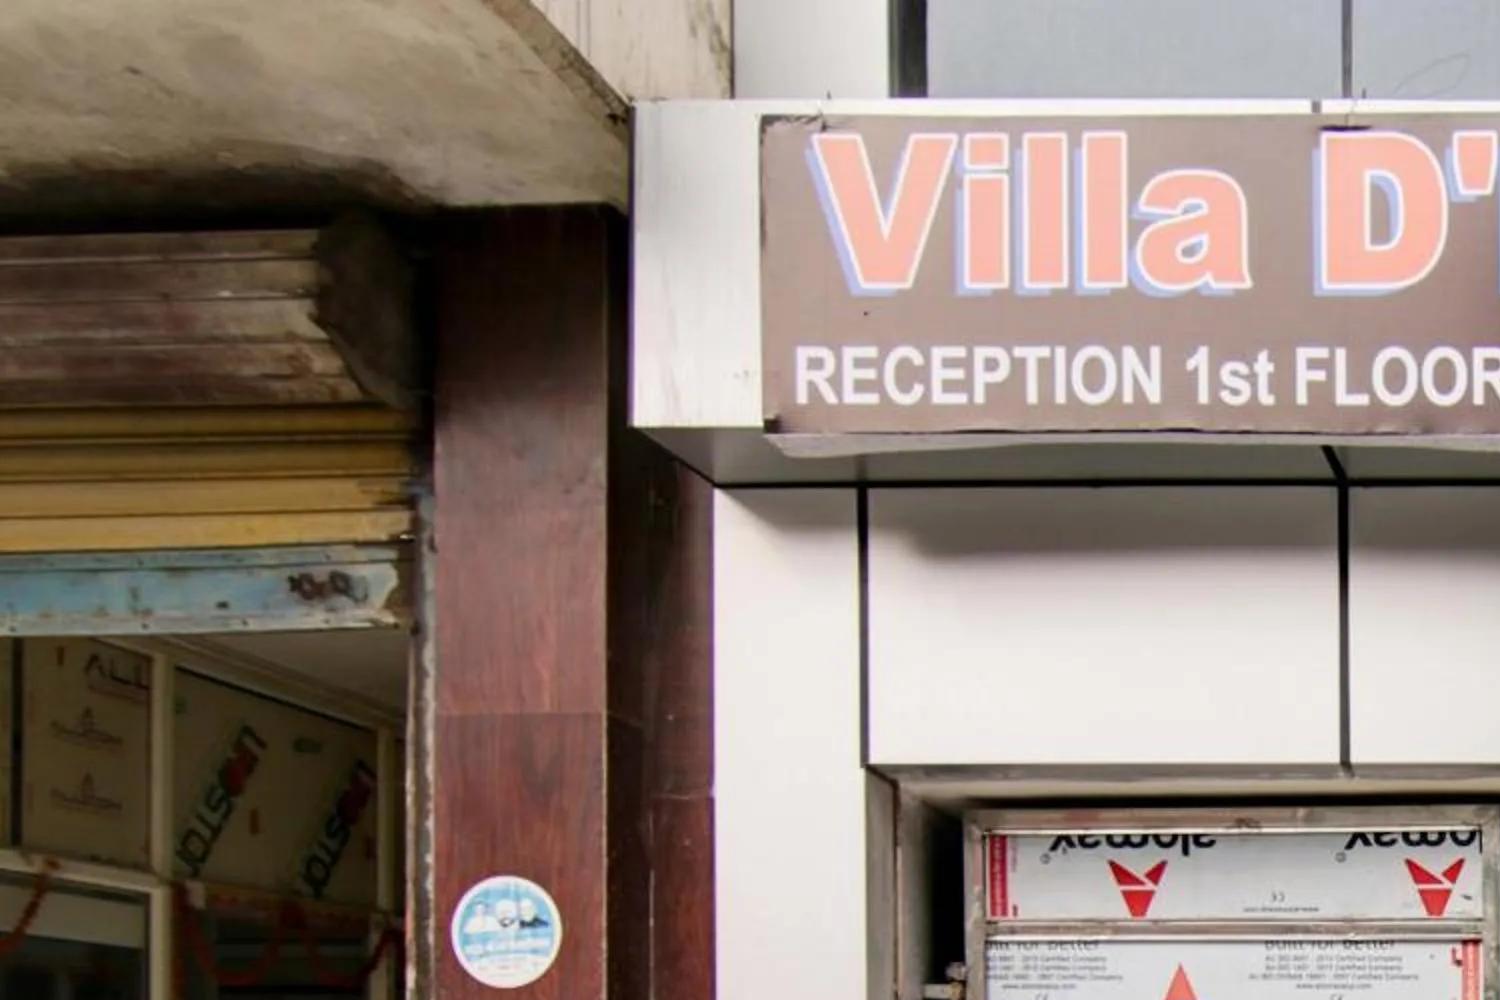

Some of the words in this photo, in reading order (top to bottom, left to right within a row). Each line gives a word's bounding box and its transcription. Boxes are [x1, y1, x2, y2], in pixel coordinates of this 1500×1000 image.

[806, 127, 1253, 297] Villa
[794, 346, 1164, 407] RECEPTION
[1186, 346, 1275, 407] 1st
